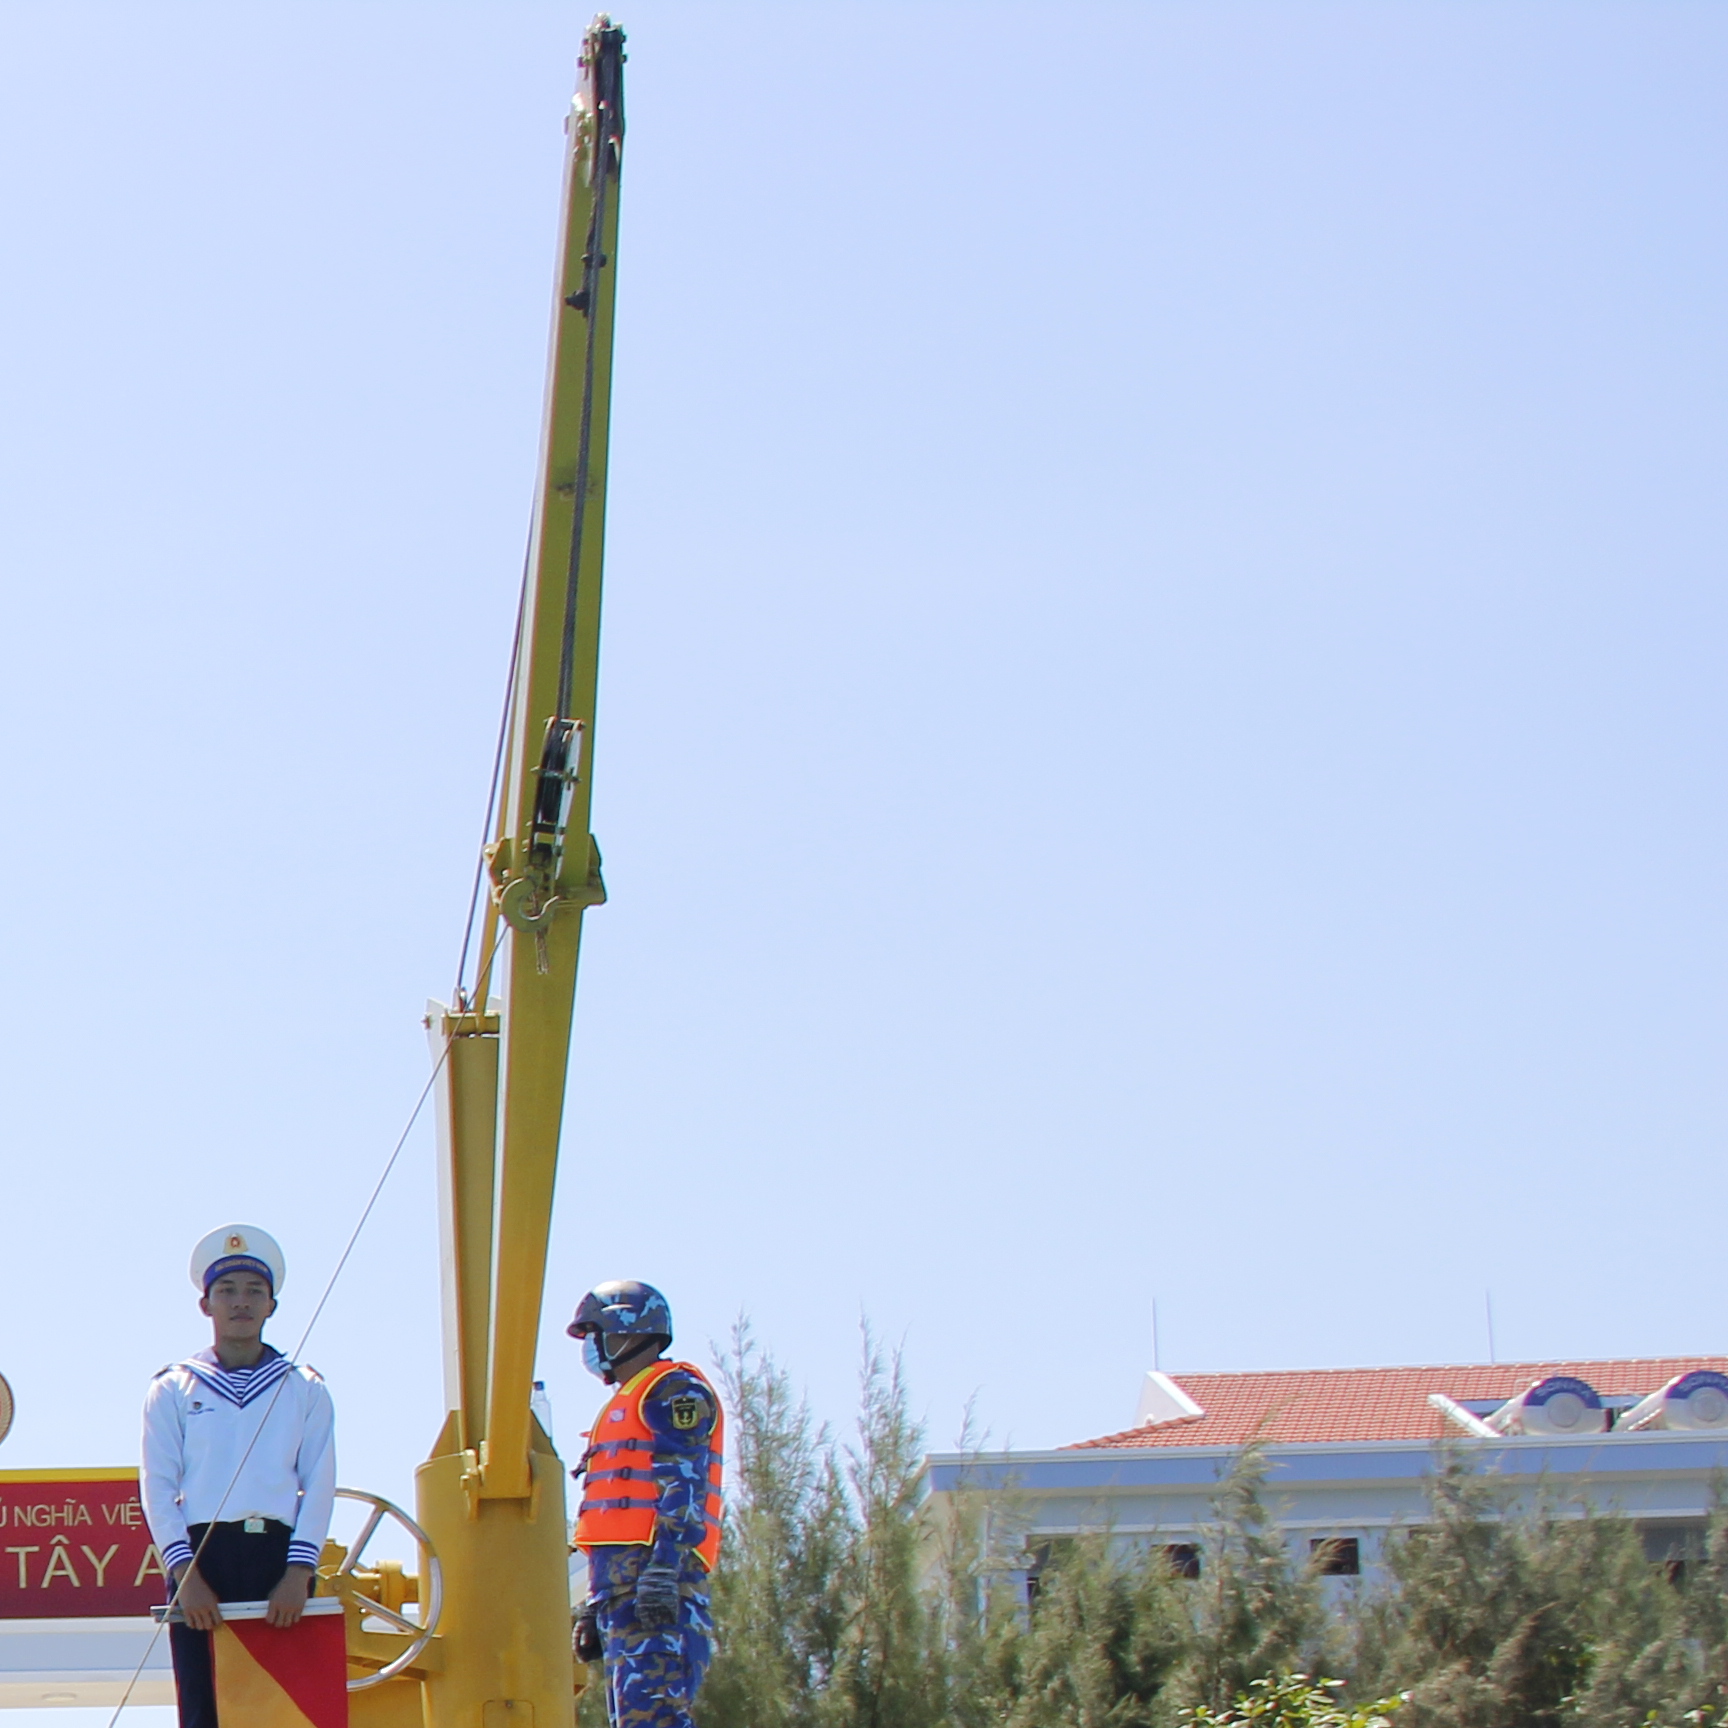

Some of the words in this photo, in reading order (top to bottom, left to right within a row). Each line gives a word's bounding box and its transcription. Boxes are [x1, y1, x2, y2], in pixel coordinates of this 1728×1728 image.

[14, 1498, 92, 1527] NGHĨA
[101, 1496, 142, 1530] VIỆ
[4, 1534, 119, 1588] TÂY
[133, 1544, 169, 1587] A
